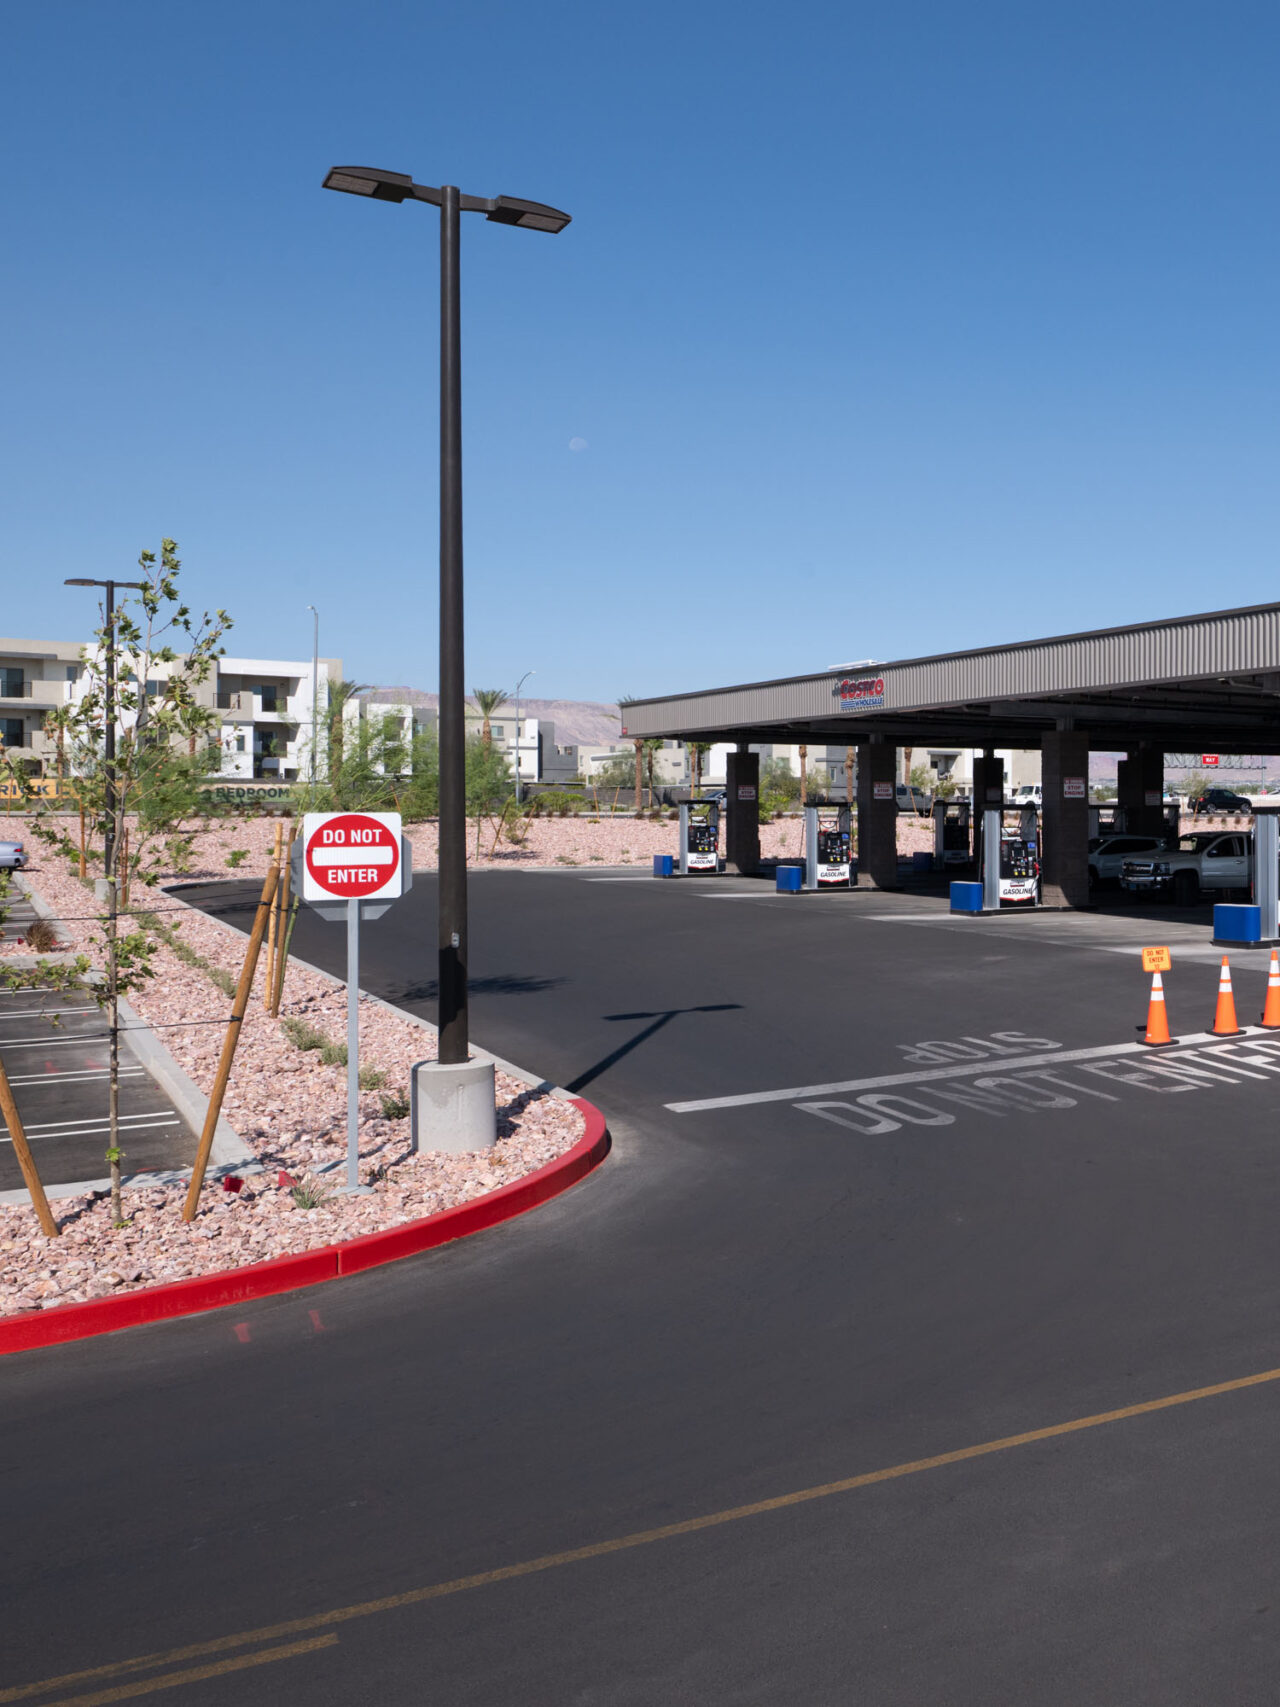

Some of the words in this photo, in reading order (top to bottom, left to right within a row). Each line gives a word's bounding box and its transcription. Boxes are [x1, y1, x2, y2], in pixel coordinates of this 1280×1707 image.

[840, 678, 884, 699] COSTCO
[216, 787, 290, 798] BEDROOM
[323, 829, 345, 844] DO
[351, 829, 382, 844] NOT
[328, 868, 378, 884] ENTER
[896, 1031, 1063, 1064] STOP
[792, 1094, 956, 1135] DO
[916, 1069, 1120, 1116] NOT
